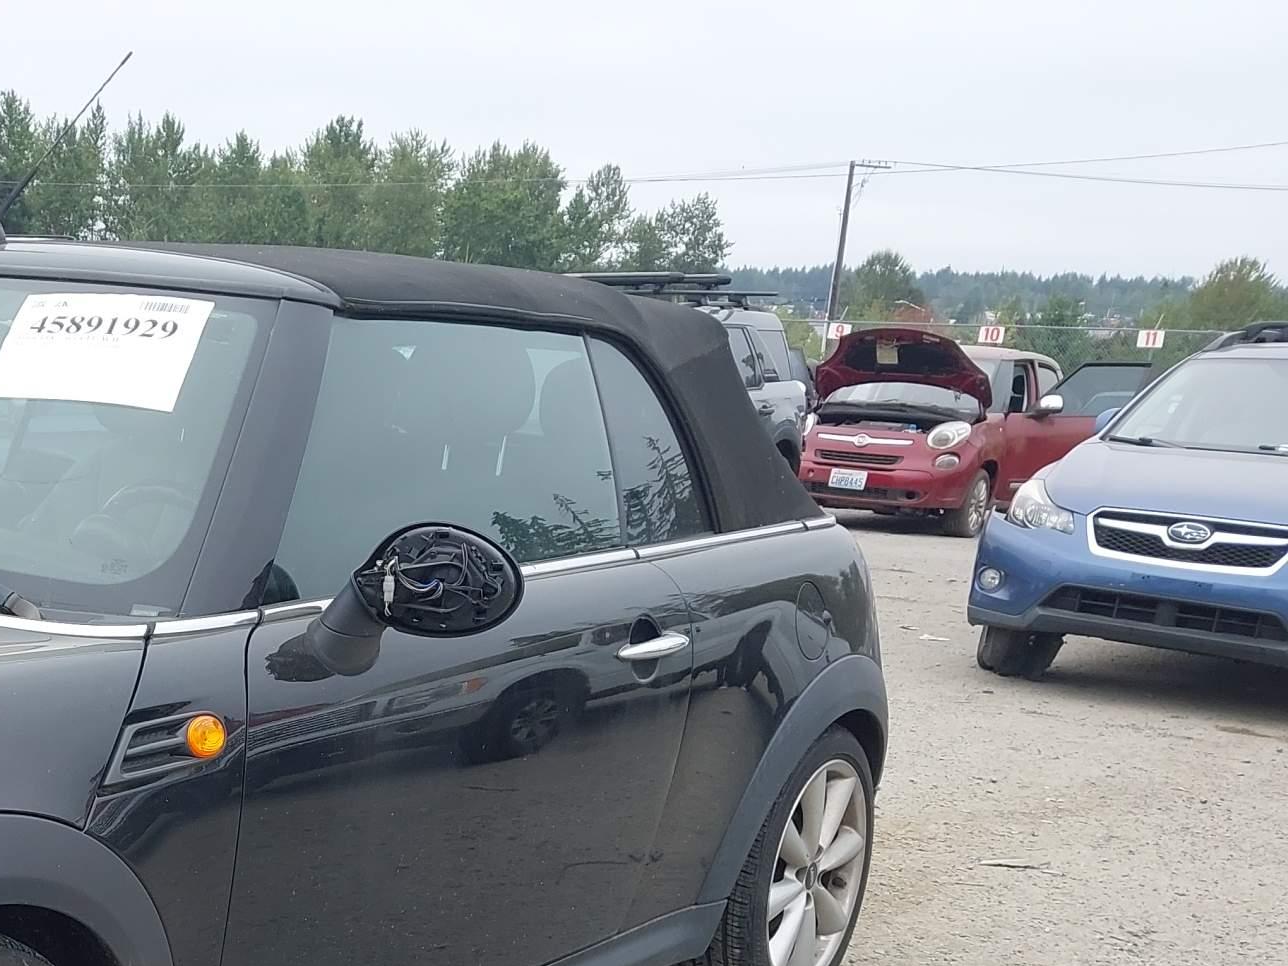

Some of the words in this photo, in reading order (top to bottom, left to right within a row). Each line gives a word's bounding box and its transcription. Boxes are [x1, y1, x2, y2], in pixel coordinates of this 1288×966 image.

[30, 316, 179, 339] 45891929
[835, 324, 845, 337] 9
[984, 327, 1000, 341] 10
[1145, 331, 1158, 346] 11
